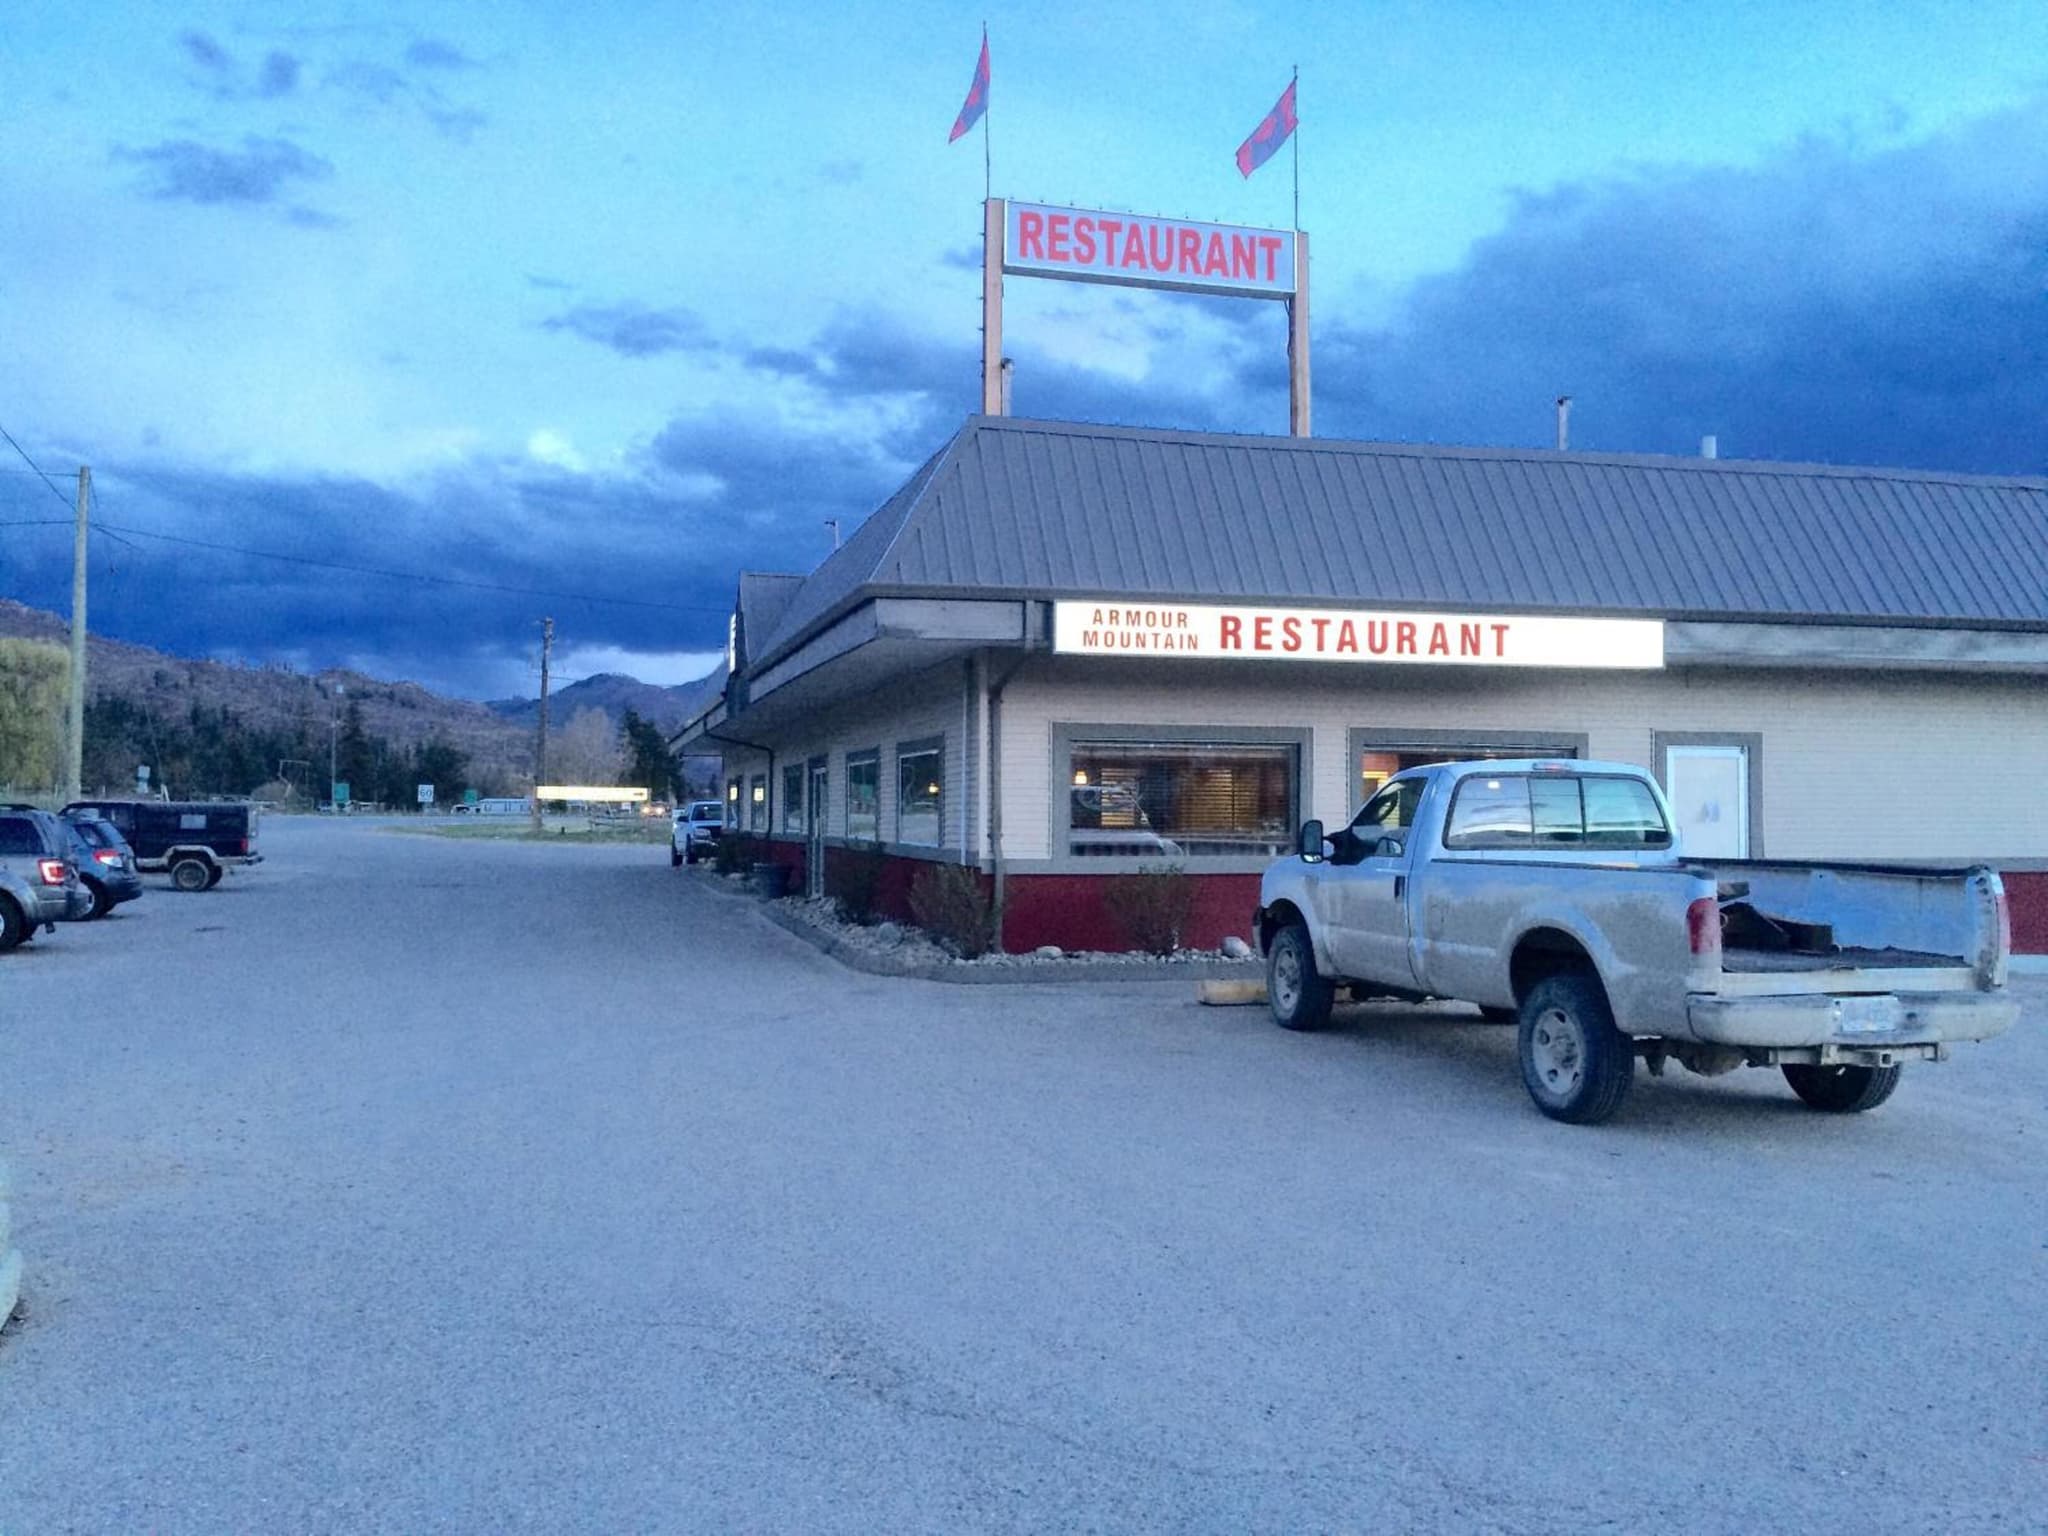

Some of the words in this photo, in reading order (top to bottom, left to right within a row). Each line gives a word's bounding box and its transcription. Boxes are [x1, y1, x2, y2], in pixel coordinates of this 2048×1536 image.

[1019, 210, 1282, 282] RESTAURANT
[1092, 608, 1188, 629] ARMOUR
[1082, 629, 1199, 650] MOUNTAIN
[1220, 615, 1510, 657] RESTAURANT
